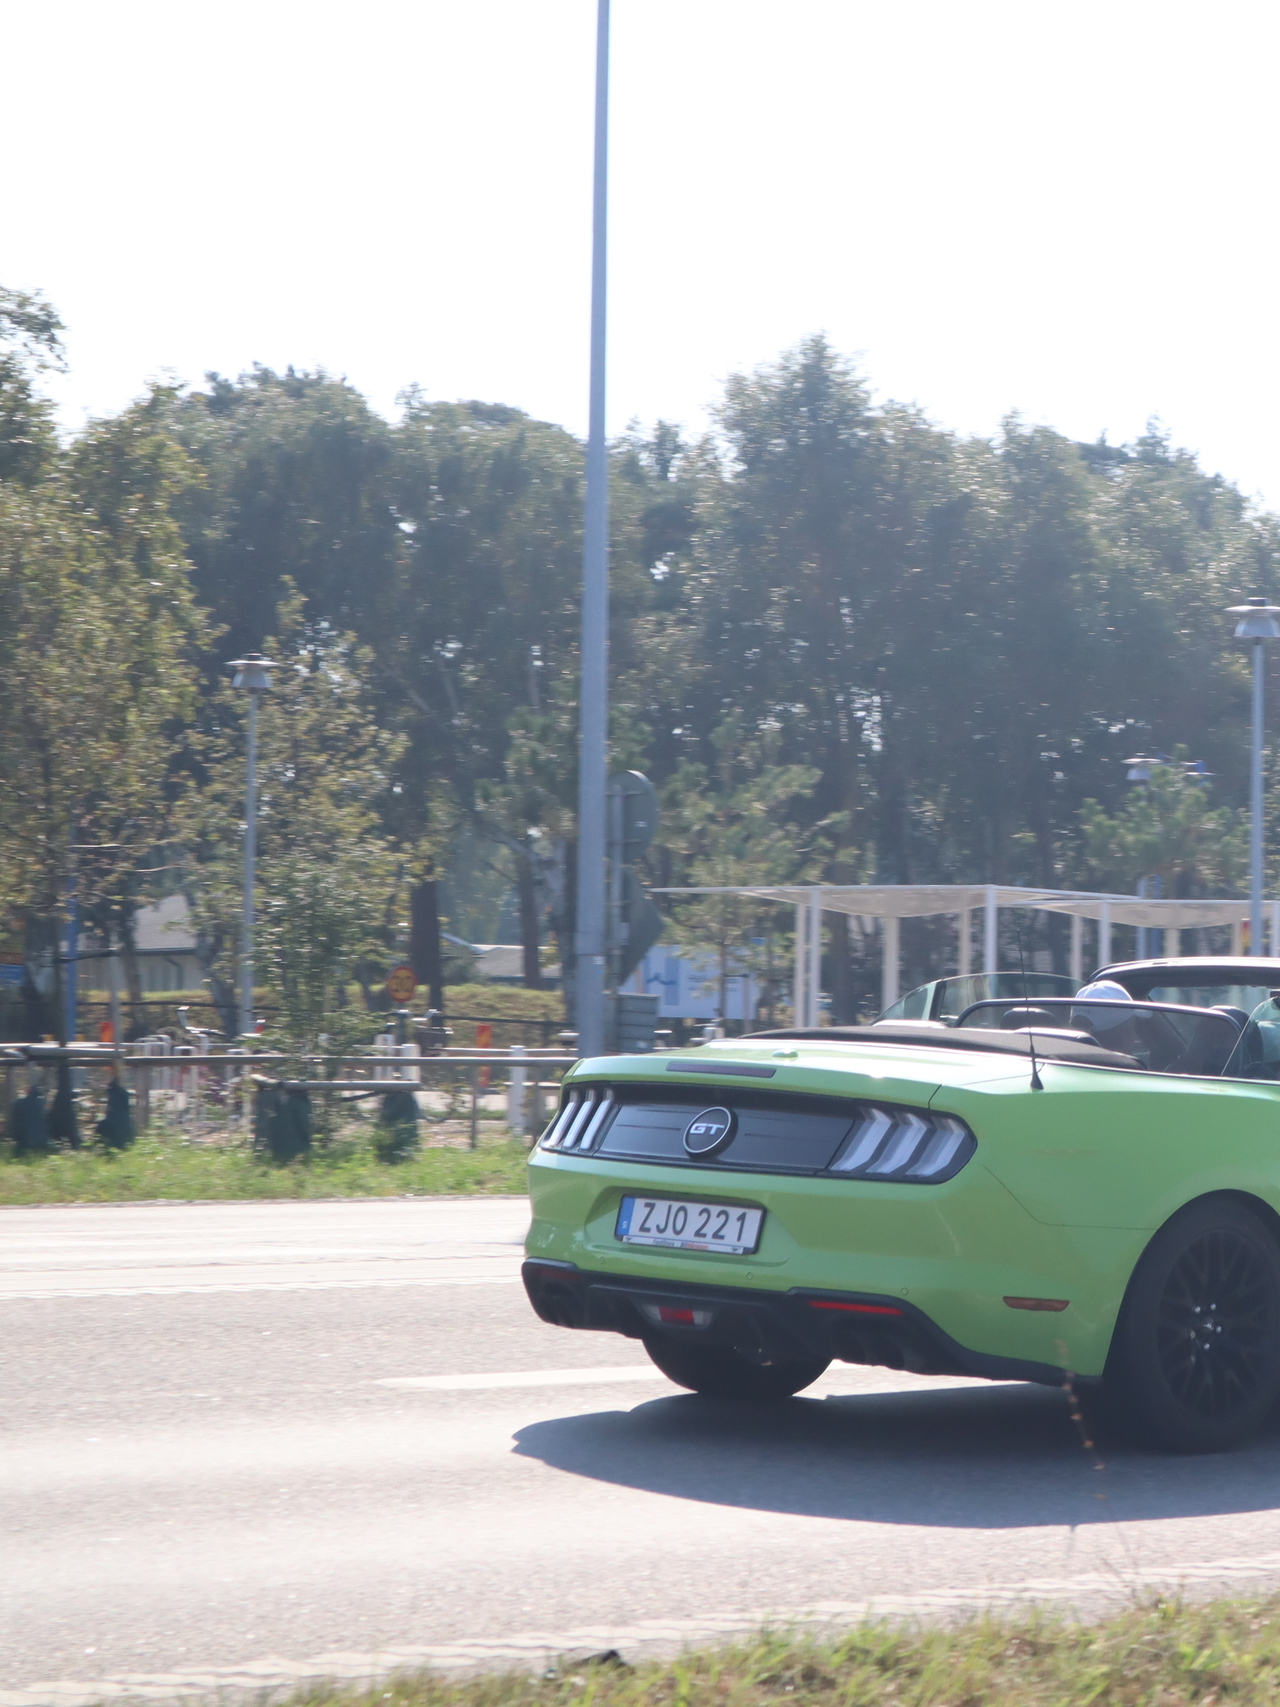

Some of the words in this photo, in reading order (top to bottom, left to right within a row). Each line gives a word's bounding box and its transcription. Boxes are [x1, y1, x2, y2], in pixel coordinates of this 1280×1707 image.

[689, 1123, 725, 1135] GT
[621, 1220, 627, 1229] S
[638, 1202, 688, 1236] ZJO
[693, 1207, 748, 1242] 221
